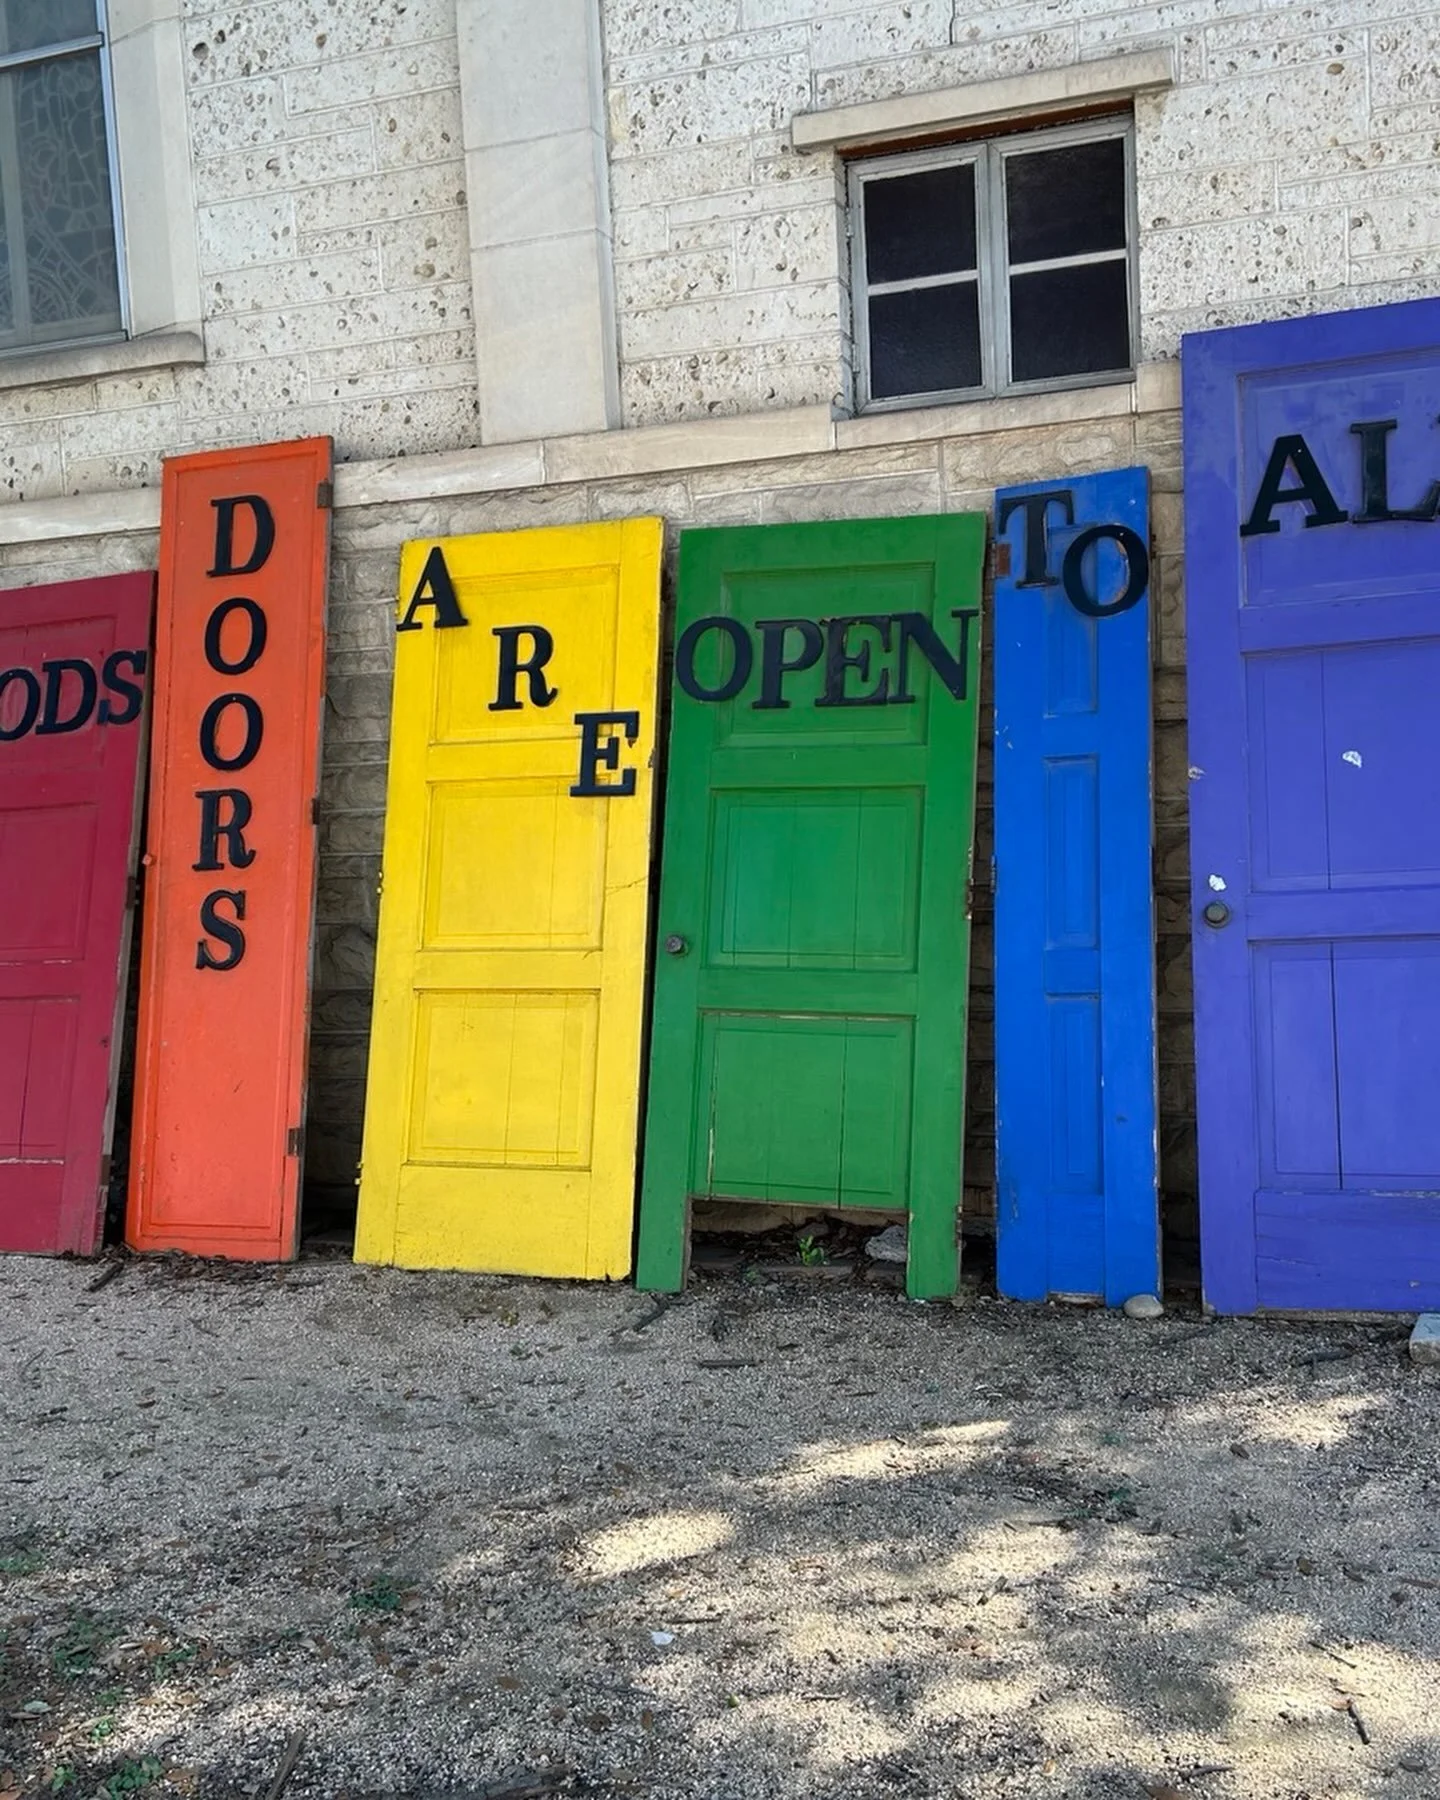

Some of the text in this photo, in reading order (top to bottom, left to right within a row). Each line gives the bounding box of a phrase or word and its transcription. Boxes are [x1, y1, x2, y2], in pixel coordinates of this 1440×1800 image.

[1240, 418, 1440, 537] AL
[1000, 490, 1149, 617] TO
[0, 650, 147, 741] ODS
[396, 546, 640, 797] ARE
[675, 609, 978, 709] OPEN
[190, 495, 276, 971] DOORS
